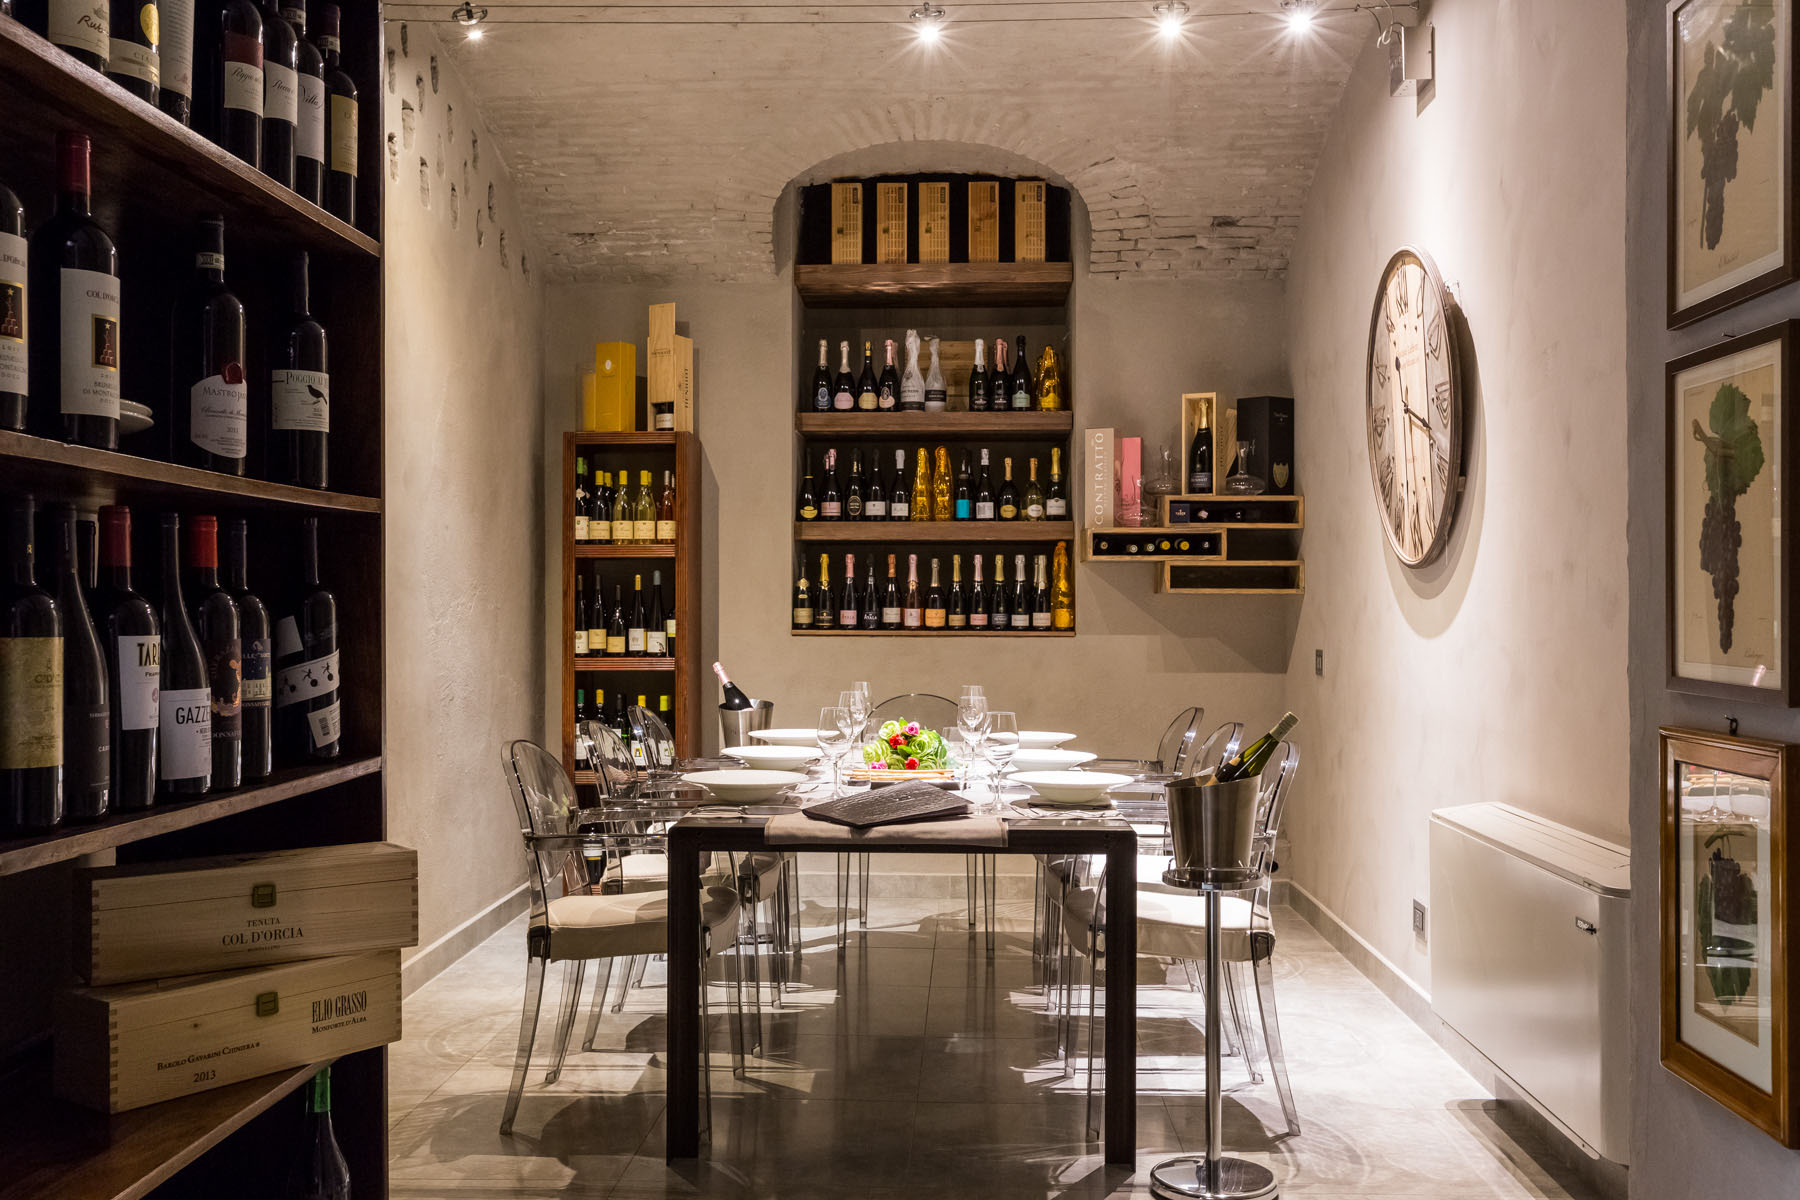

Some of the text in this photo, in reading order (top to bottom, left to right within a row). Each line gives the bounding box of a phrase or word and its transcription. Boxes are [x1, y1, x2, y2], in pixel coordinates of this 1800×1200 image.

[1094, 432, 1104, 526] CONTRATTO
[247, 917, 281, 928] TENUTA
[222, 927, 304, 946] COL D'ORCIA
[311, 990, 368, 1024] ELIO GRASSO
[311, 1020, 344, 1034] MONFORTE
[157, 1042, 255, 1071] BAROLO GAVARINI CHINIERA
[193, 1070, 216, 1082] 2013
